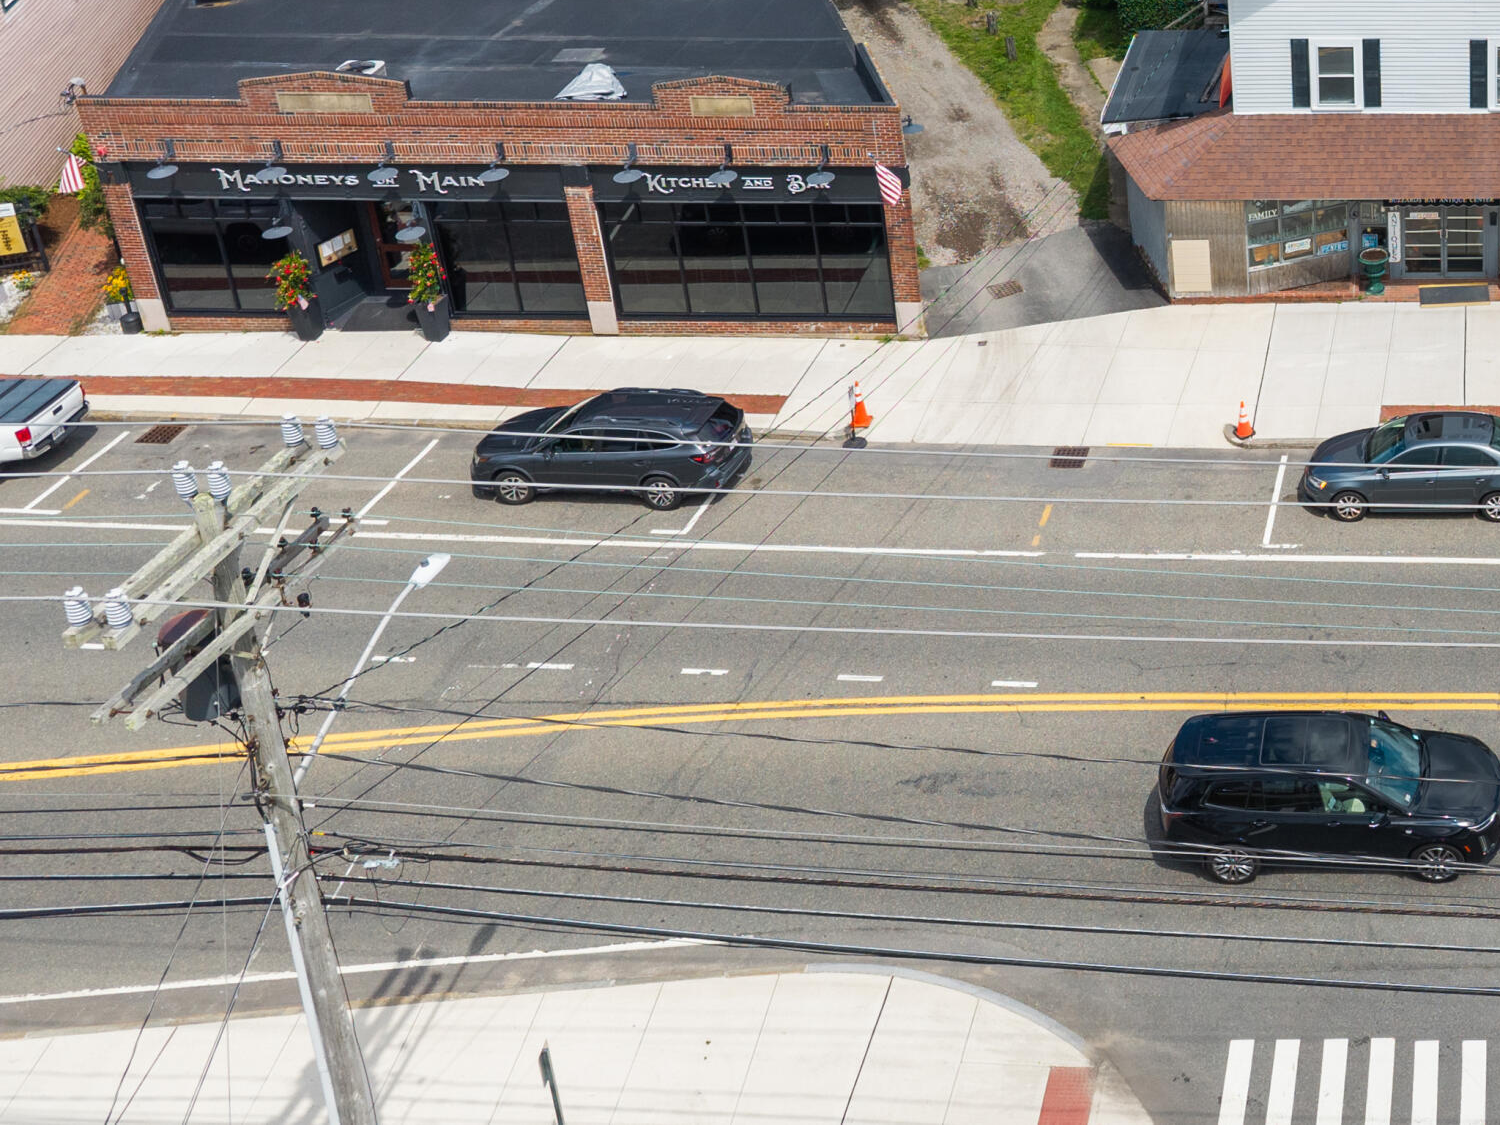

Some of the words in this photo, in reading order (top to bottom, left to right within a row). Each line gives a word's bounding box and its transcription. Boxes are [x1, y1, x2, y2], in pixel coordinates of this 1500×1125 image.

[408, 169, 486, 194] MAIN
[641, 173, 731, 194] KITCHEN
[744, 179, 773, 187] AND
[1248, 209, 1278, 222] FAMILY
[1390, 213, 1398, 262] ANTIQUES
